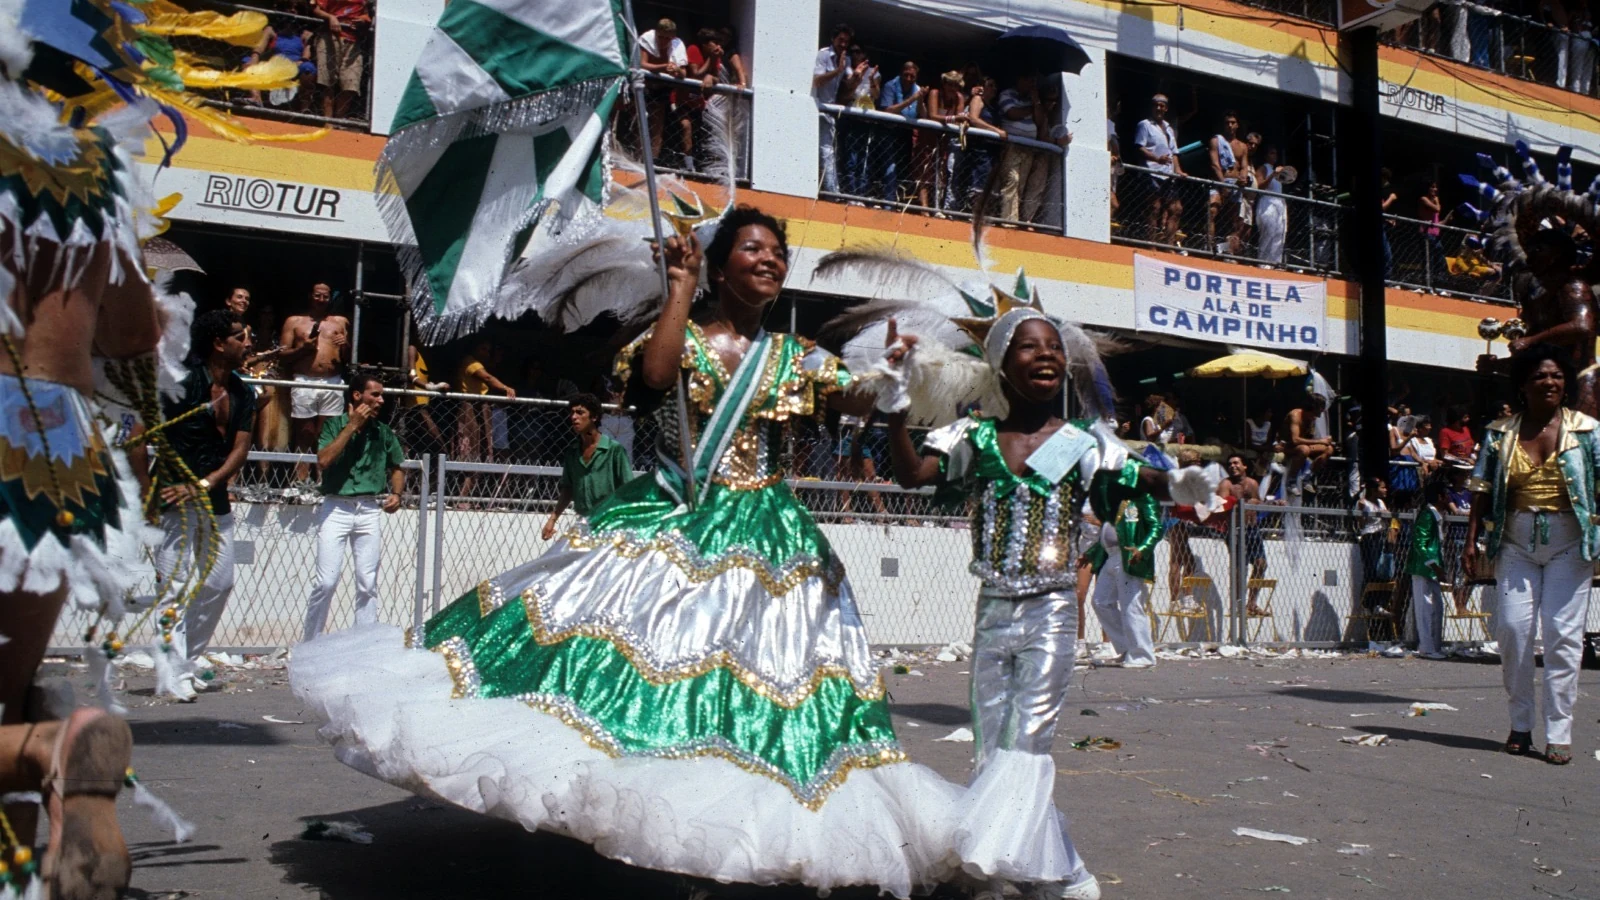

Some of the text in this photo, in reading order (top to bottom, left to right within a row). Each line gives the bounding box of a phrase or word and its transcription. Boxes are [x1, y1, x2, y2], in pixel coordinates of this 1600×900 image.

[1387, 84, 1445, 113] RIOTUR
[204, 175, 341, 218] RIOTUR
[1164, 267, 1302, 303] PORTELA
[1149, 305, 1318, 344] CAMPINHO
[1202, 297, 1272, 318] ALA DE
